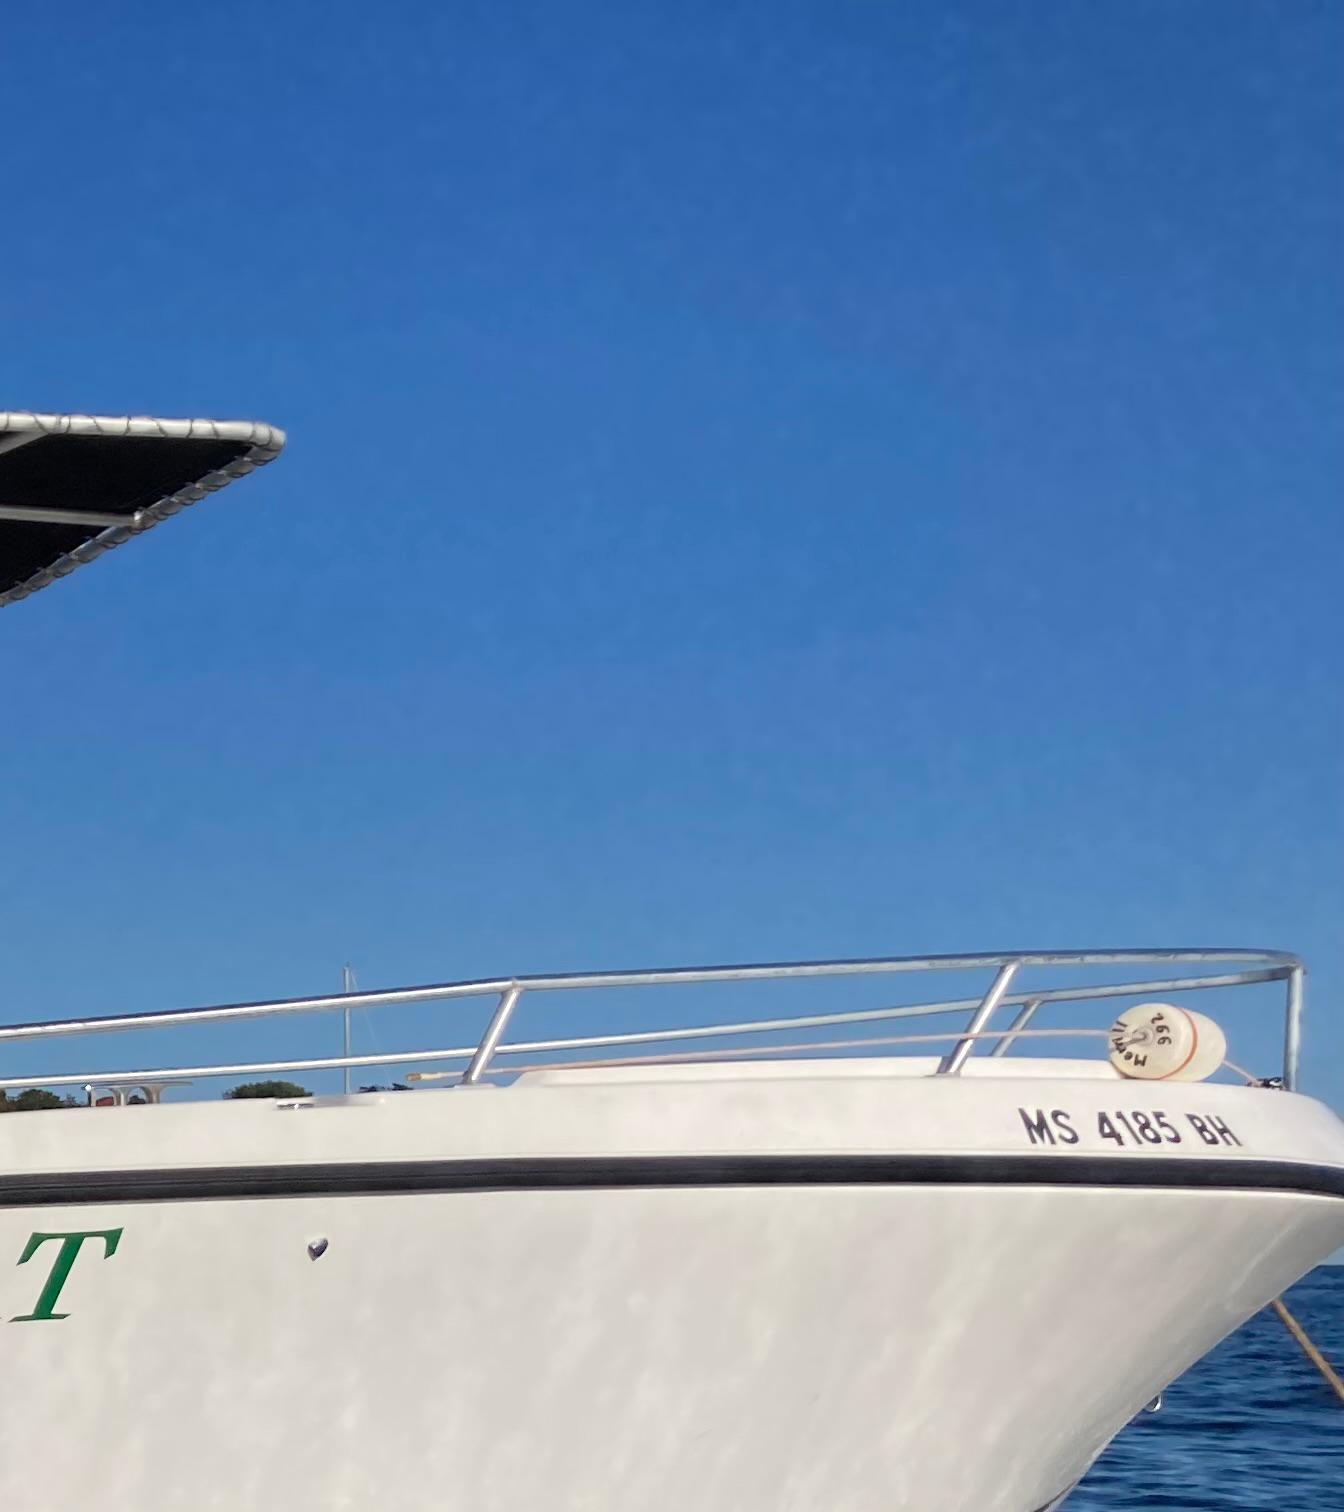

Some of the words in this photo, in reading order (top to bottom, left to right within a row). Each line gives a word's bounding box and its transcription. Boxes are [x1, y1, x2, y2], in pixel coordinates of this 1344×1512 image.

[1017, 1107, 1080, 1146] MS
[1097, 1110, 1182, 1147] 4185
[1184, 1113, 1244, 1147] BH
